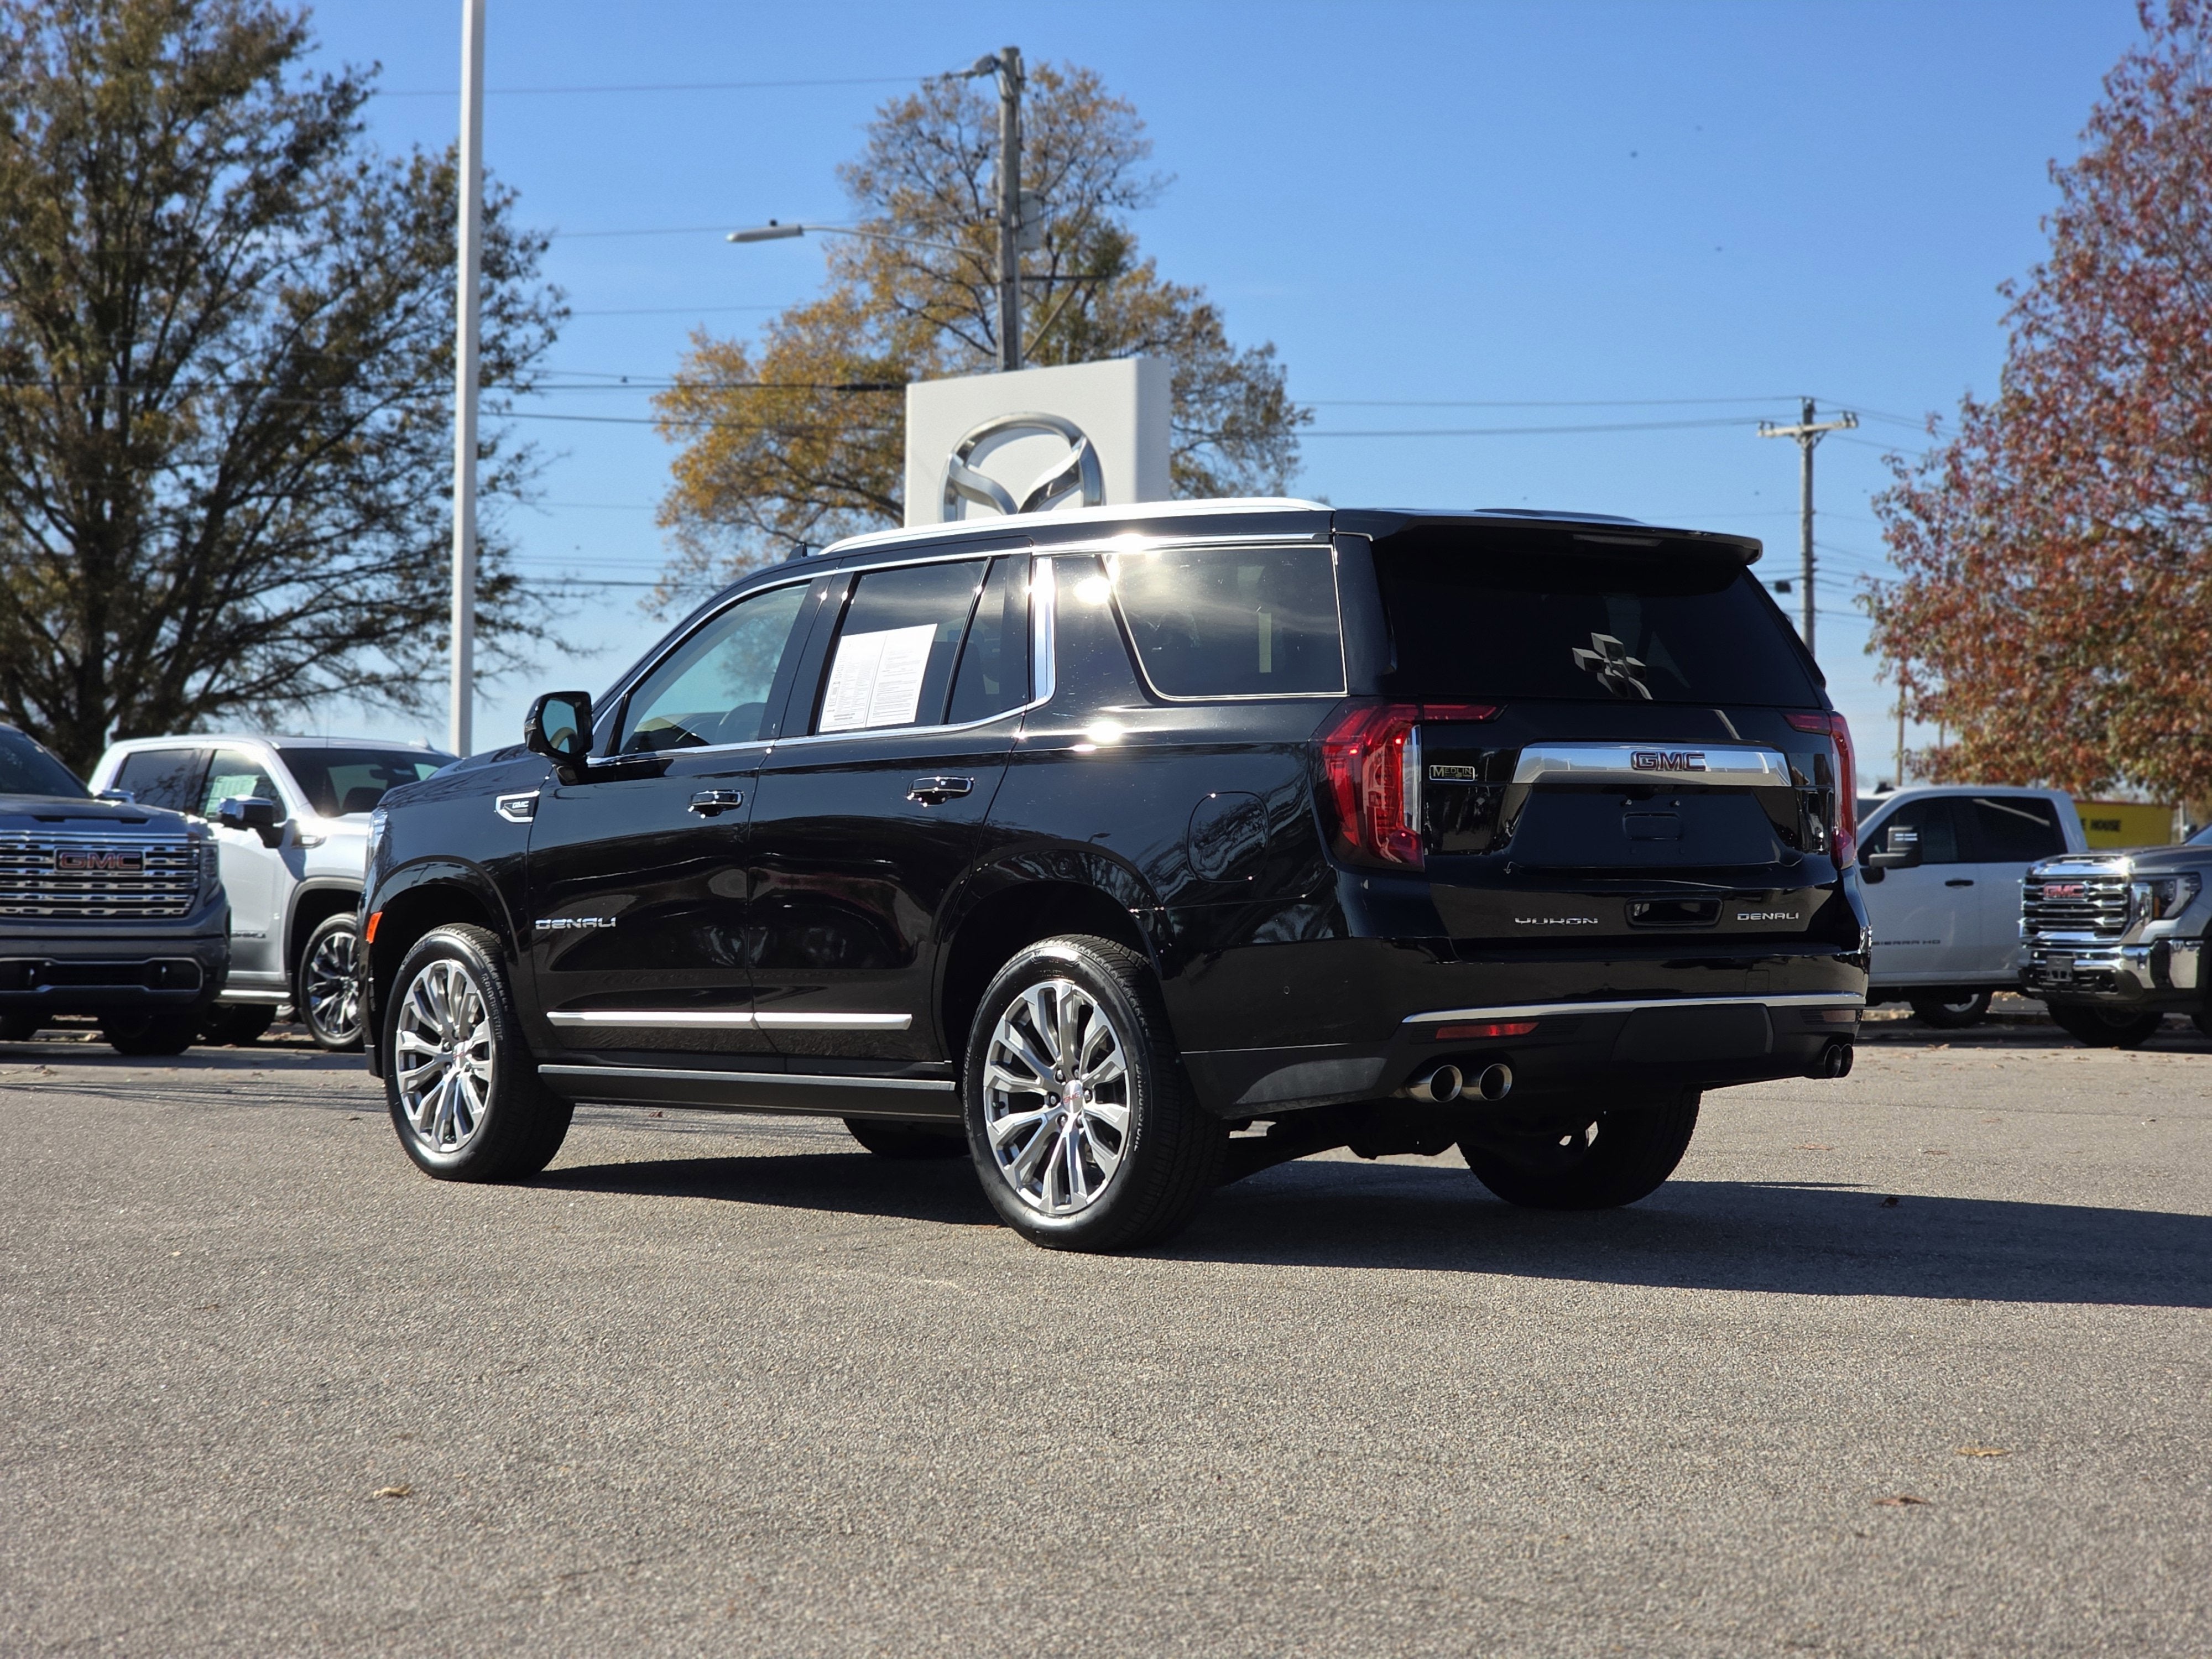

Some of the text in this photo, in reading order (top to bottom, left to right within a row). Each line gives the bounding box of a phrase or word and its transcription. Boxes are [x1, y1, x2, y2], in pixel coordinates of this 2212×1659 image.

[1631, 751, 1705, 771] GMC
[1433, 766, 1472, 777] MEDLIN
[60, 852, 141, 869] GMC
[2044, 885, 2084, 897] GMC
[535, 917, 617, 930] DENALI
